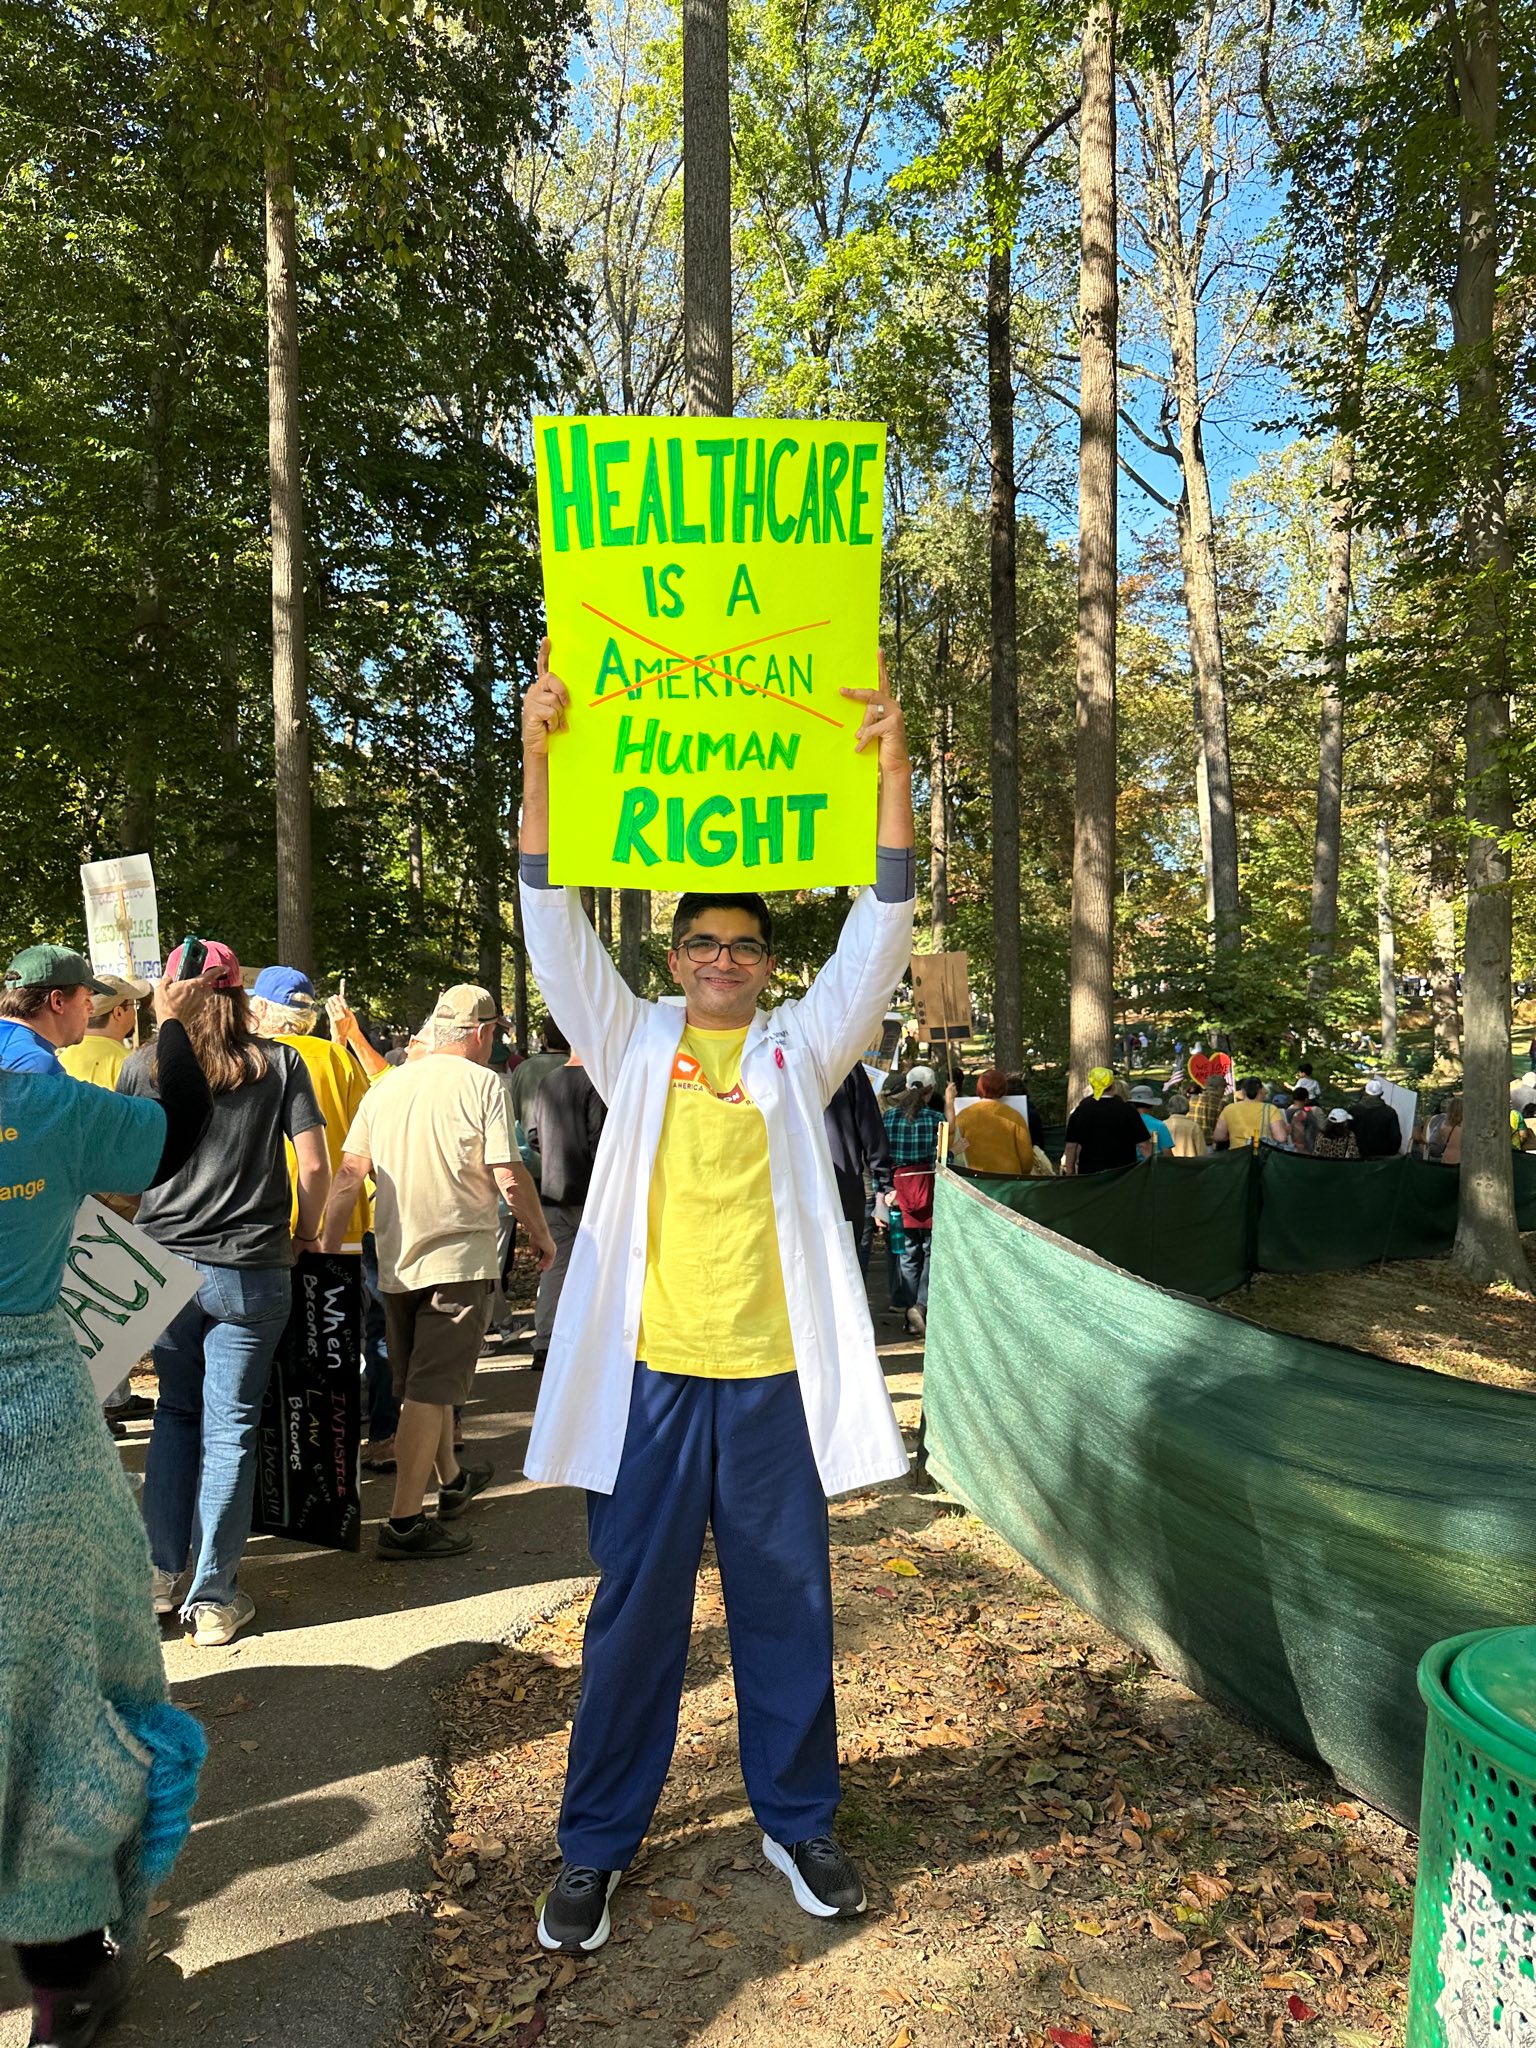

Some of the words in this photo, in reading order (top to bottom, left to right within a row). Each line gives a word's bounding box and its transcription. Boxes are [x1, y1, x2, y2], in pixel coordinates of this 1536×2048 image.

[543, 424, 878, 552] HEALTHCARE
[642, 563, 685, 618] IS
[727, 564, 760, 616] A
[595, 637, 813, 699] AMERICAN
[613, 715, 801, 774] HUMAN
[612, 786, 828, 867] RIGHT
[673, 1082, 703, 1092] AMERICA
[57, 1214, 167, 1359] ACY
[302, 1274, 319, 1358] Becomes
[322, 1285, 346, 1369] When
[287, 1397, 303, 1471] Becomes
[305, 1389, 324, 1447] LAW
[330, 1390, 347, 1498] INJUSTICE
